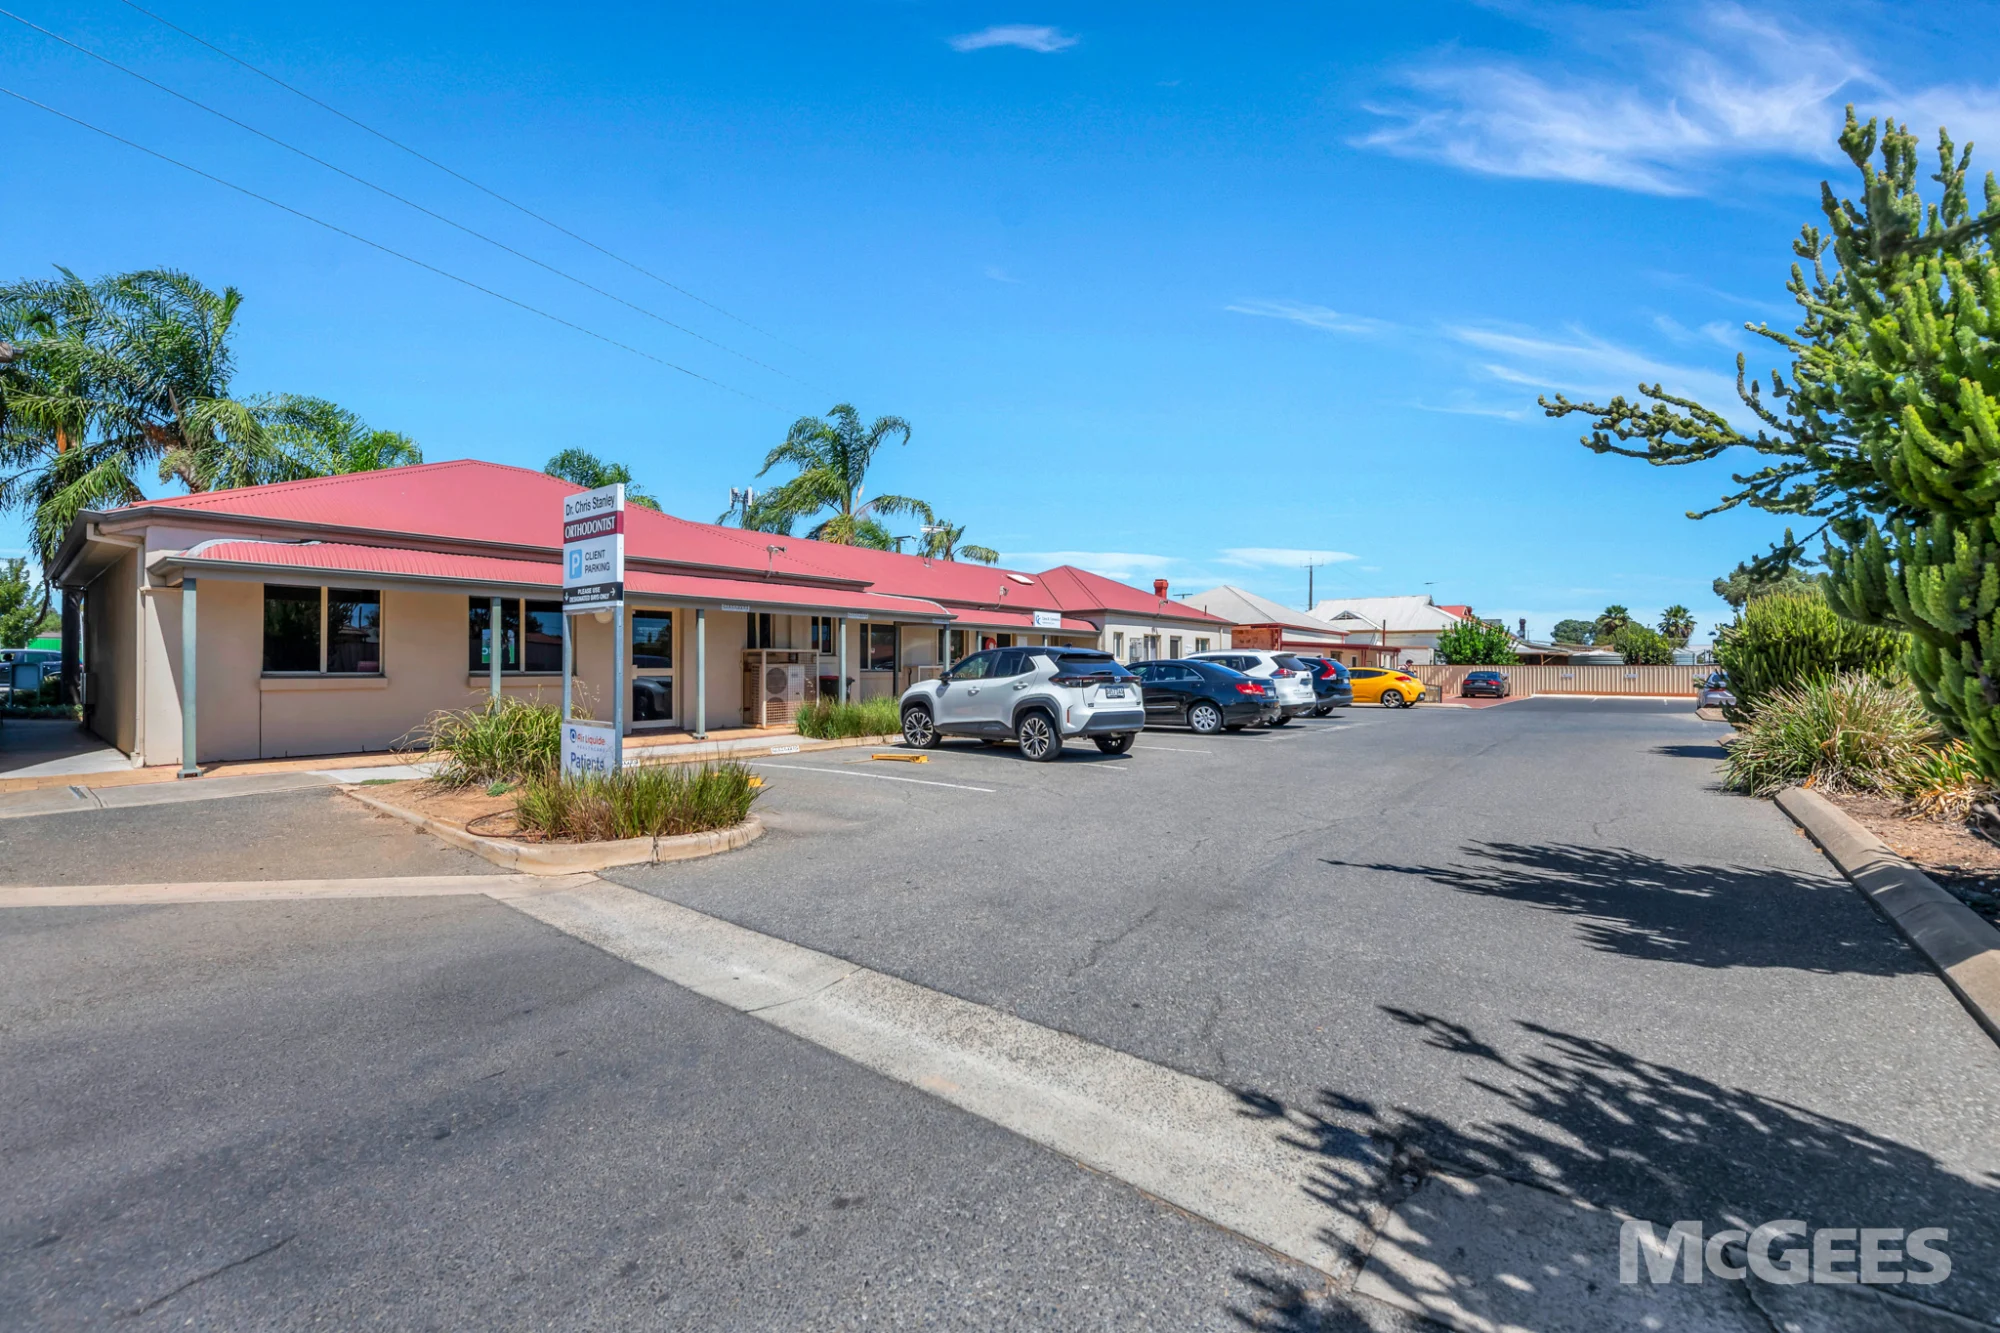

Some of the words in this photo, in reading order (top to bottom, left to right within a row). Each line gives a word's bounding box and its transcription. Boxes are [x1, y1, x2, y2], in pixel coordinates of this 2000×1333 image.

[565, 504, 573, 517] Dr.
[575, 500, 591, 514] Chris
[593, 495, 615, 510] Stanley
[565, 516, 616, 538] ORTHODONTIST
[571, 553, 581, 576] P
[585, 550, 605, 561] CLIENT
[585, 562, 610, 574] PARKING
[577, 733, 585, 743] Air
[585, 734, 606, 746] Liquide
[571, 752, 605, 771] Patients
